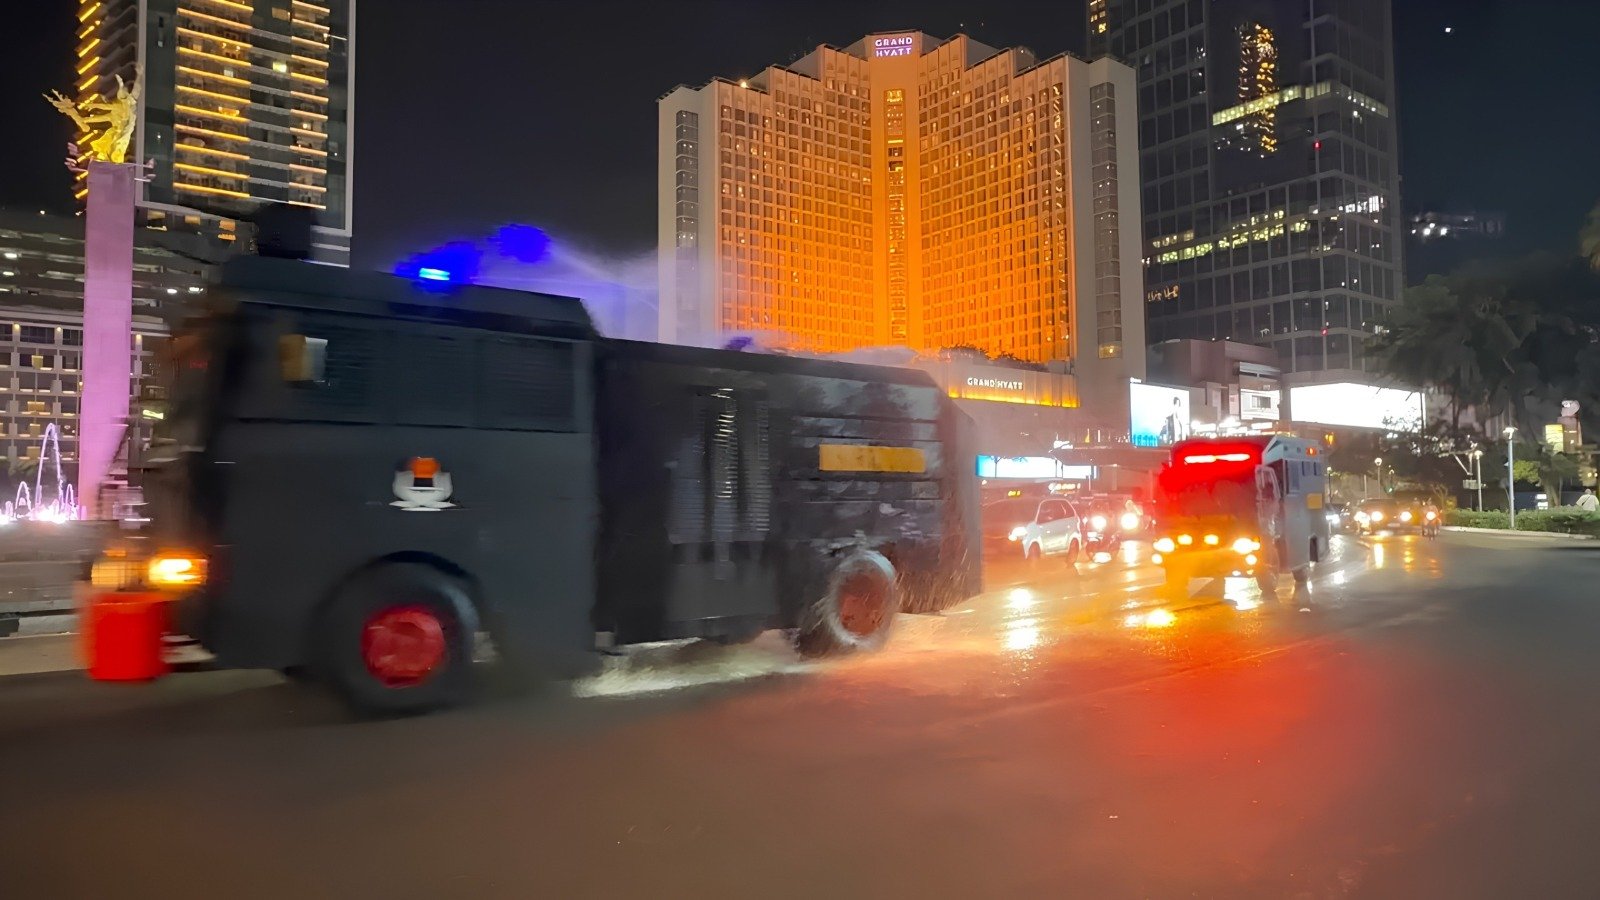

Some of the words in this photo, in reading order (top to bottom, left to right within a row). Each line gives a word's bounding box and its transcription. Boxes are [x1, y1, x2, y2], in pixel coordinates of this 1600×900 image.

[875, 37, 913, 47] GRAND
[875, 47, 912, 57] HYATT
[967, 377, 995, 388] GRAND
[997, 380, 1023, 390] HYATT
